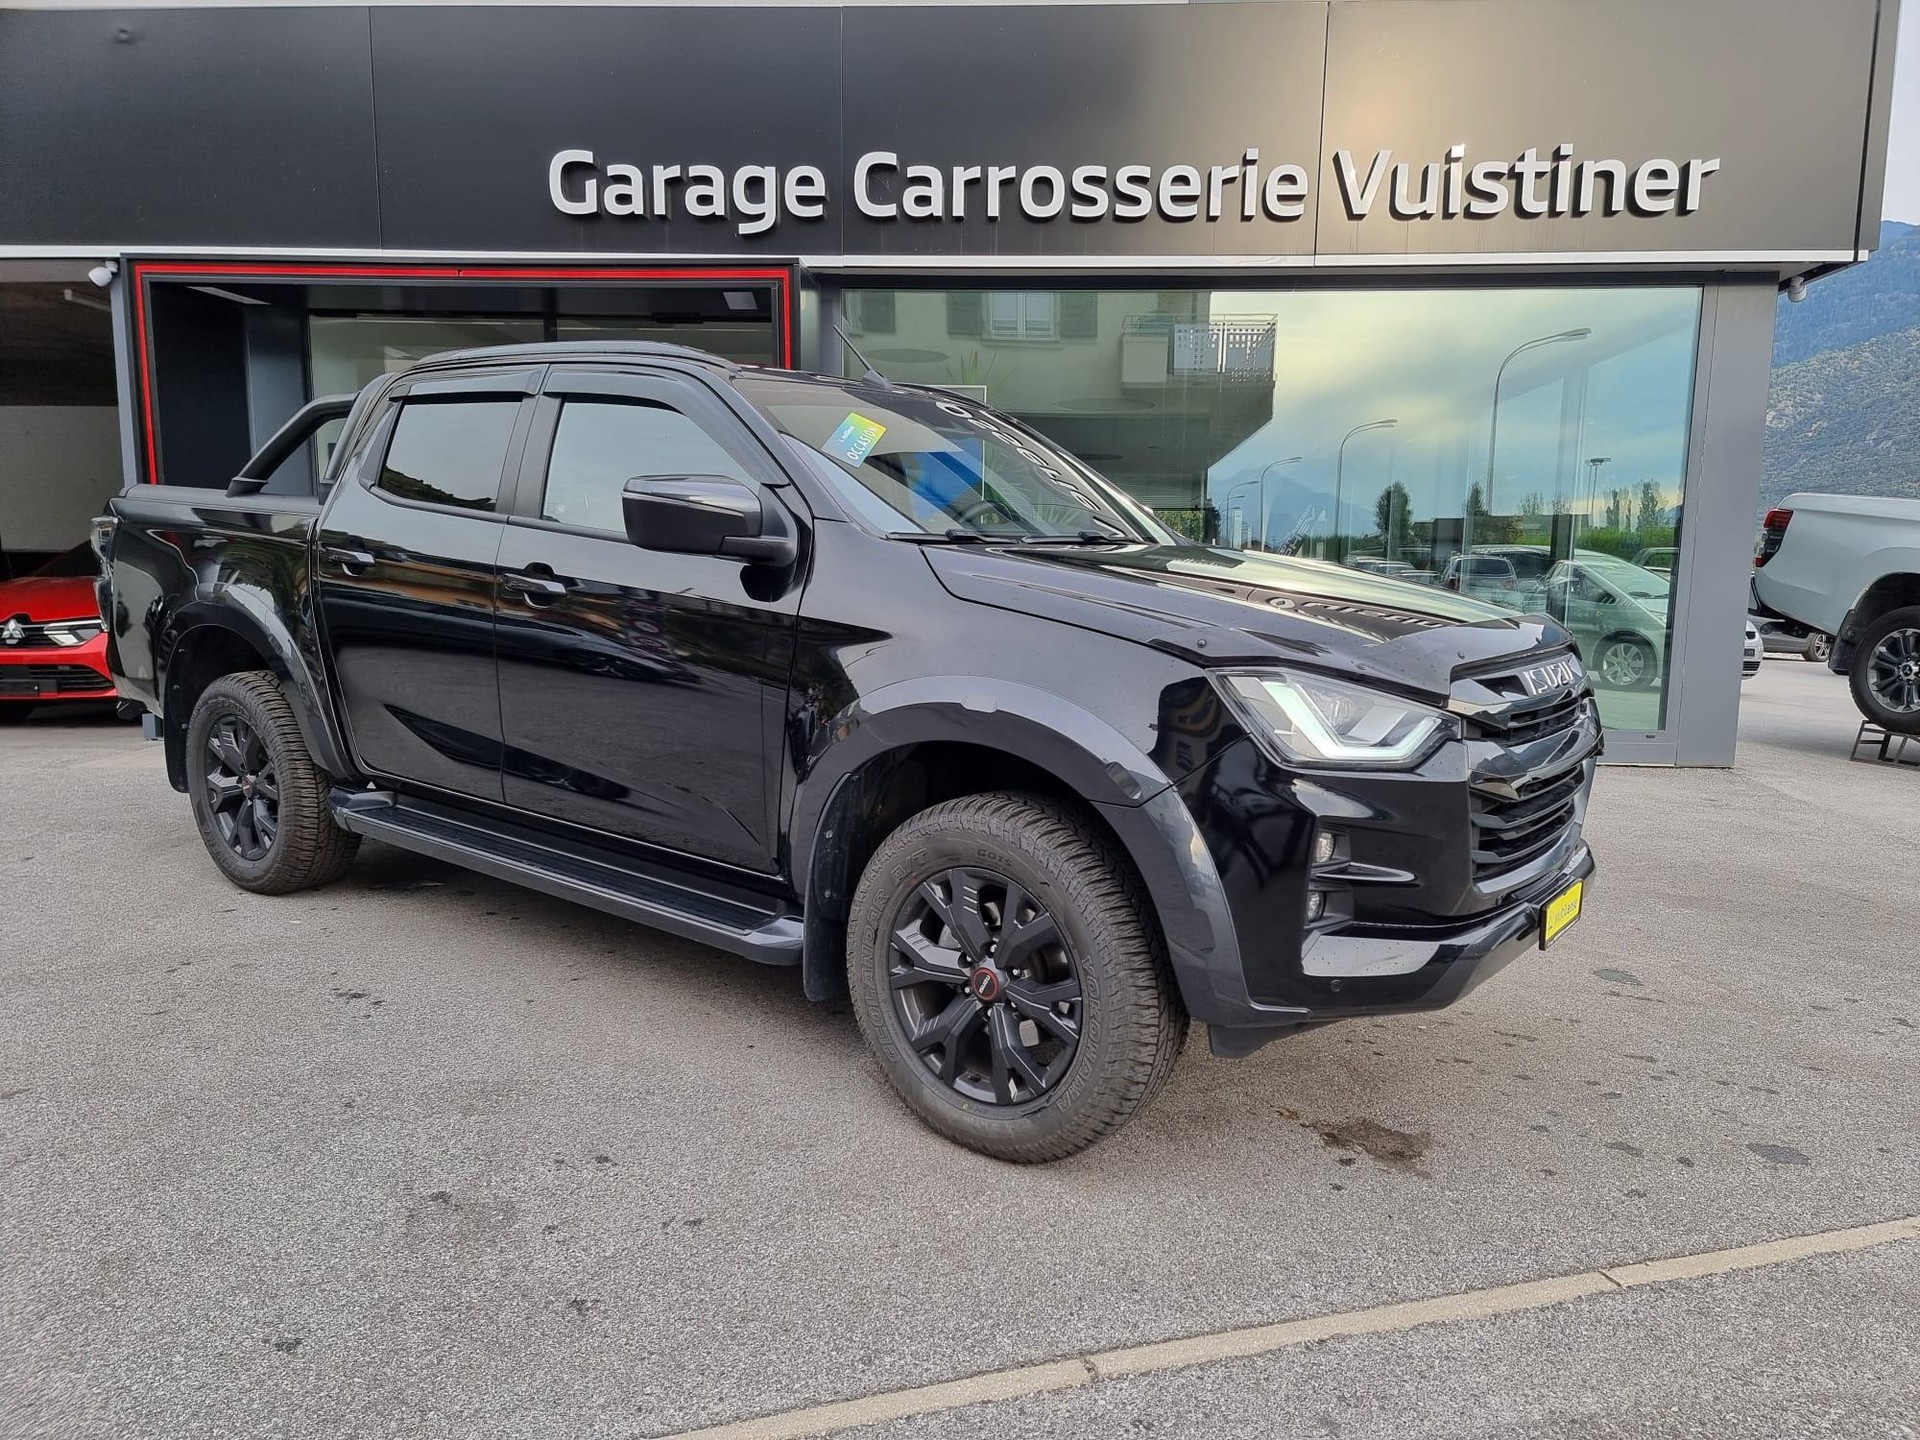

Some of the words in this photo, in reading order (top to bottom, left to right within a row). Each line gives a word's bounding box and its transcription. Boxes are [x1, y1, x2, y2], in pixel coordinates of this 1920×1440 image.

[548, 149, 825, 235] Garage
[853, 147, 1309, 219] Carrosserie
[1336, 143, 1721, 217] Vuistiner
[846, 425, 880, 461] OCCASION
[1522, 661, 1574, 696] ISUZU
[860, 889, 901, 1062] GEOLANDAR
[1056, 955, 1101, 1113] YOKOHAMA
